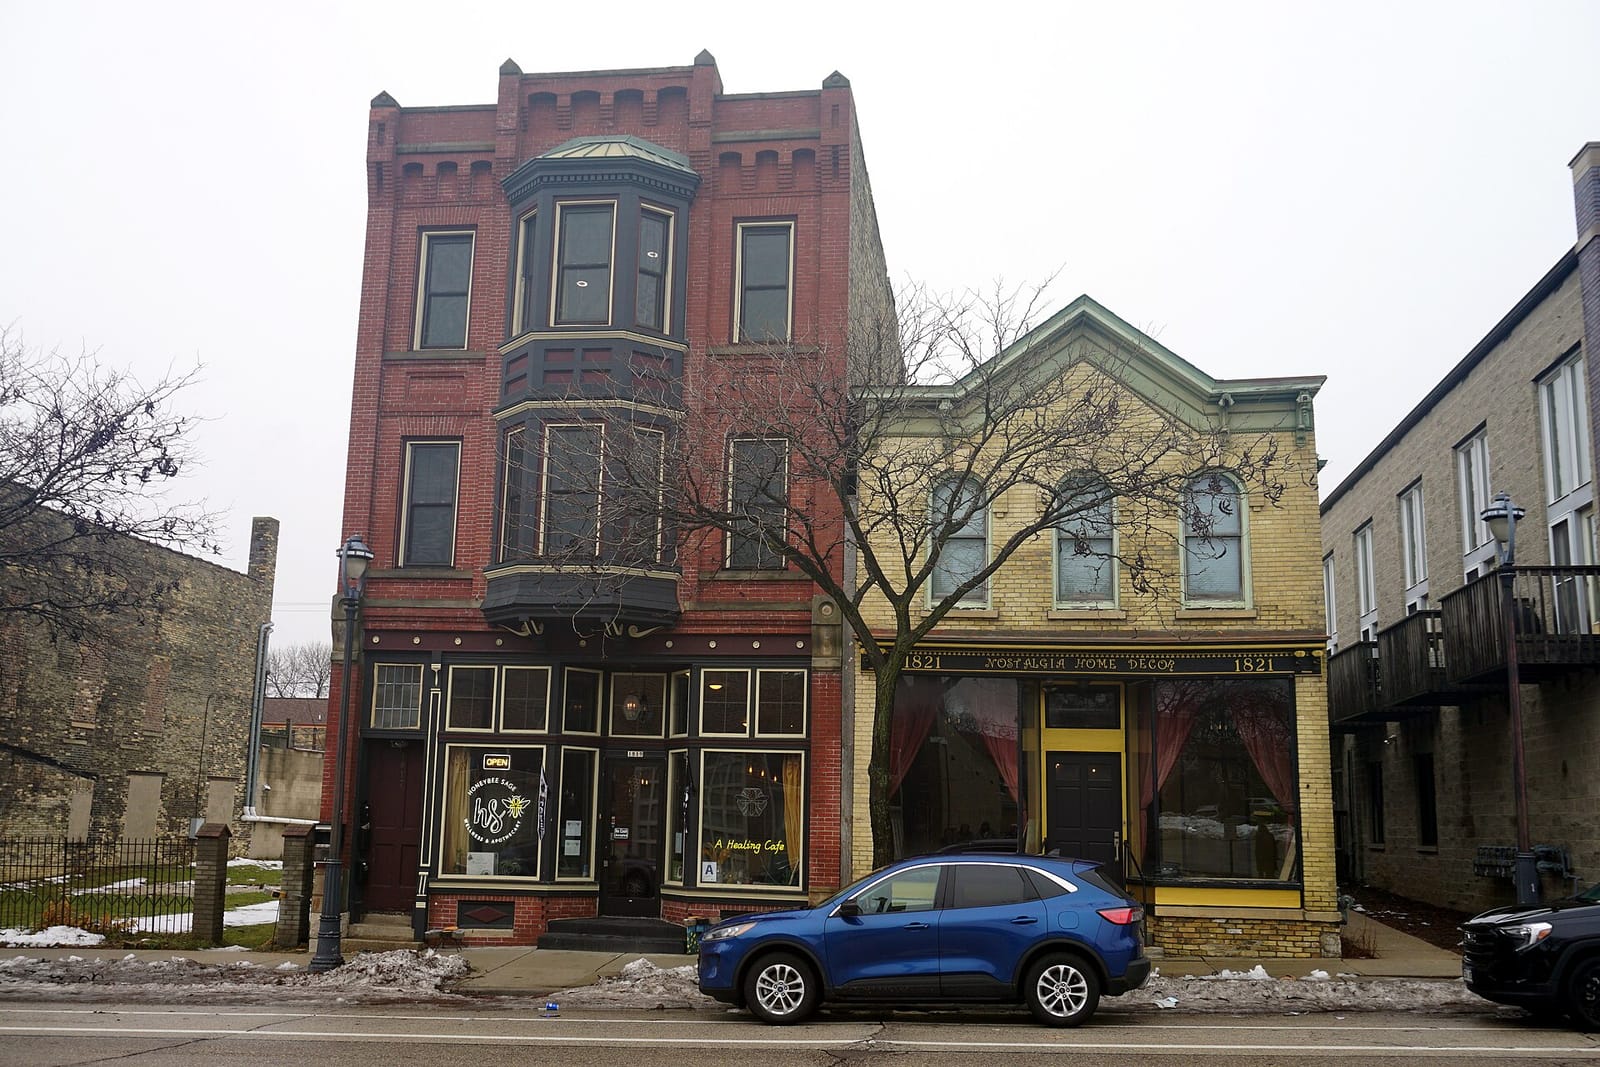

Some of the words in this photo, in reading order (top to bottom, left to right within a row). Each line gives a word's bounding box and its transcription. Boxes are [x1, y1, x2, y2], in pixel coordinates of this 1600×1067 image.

[904, 655, 941, 669] 1821
[984, 658, 1066, 670] NOSTALGIA
[1074, 658, 1117, 670] HOME
[1128, 659, 1176, 672] DECOR
[1234, 658, 1274, 672] 1821
[486, 758, 508, 767] OPEN
[467, 777, 499, 796] HONEYBEE
[501, 779, 517, 792] SAGE
[463, 818, 484, 842] WELLNESS
[491, 820, 521, 844] APOTHECARY
[714, 839, 723, 849] A
[726, 839, 761, 854] Healing
[764, 840, 785, 854] Cafe
[705, 864, 714, 875] A
